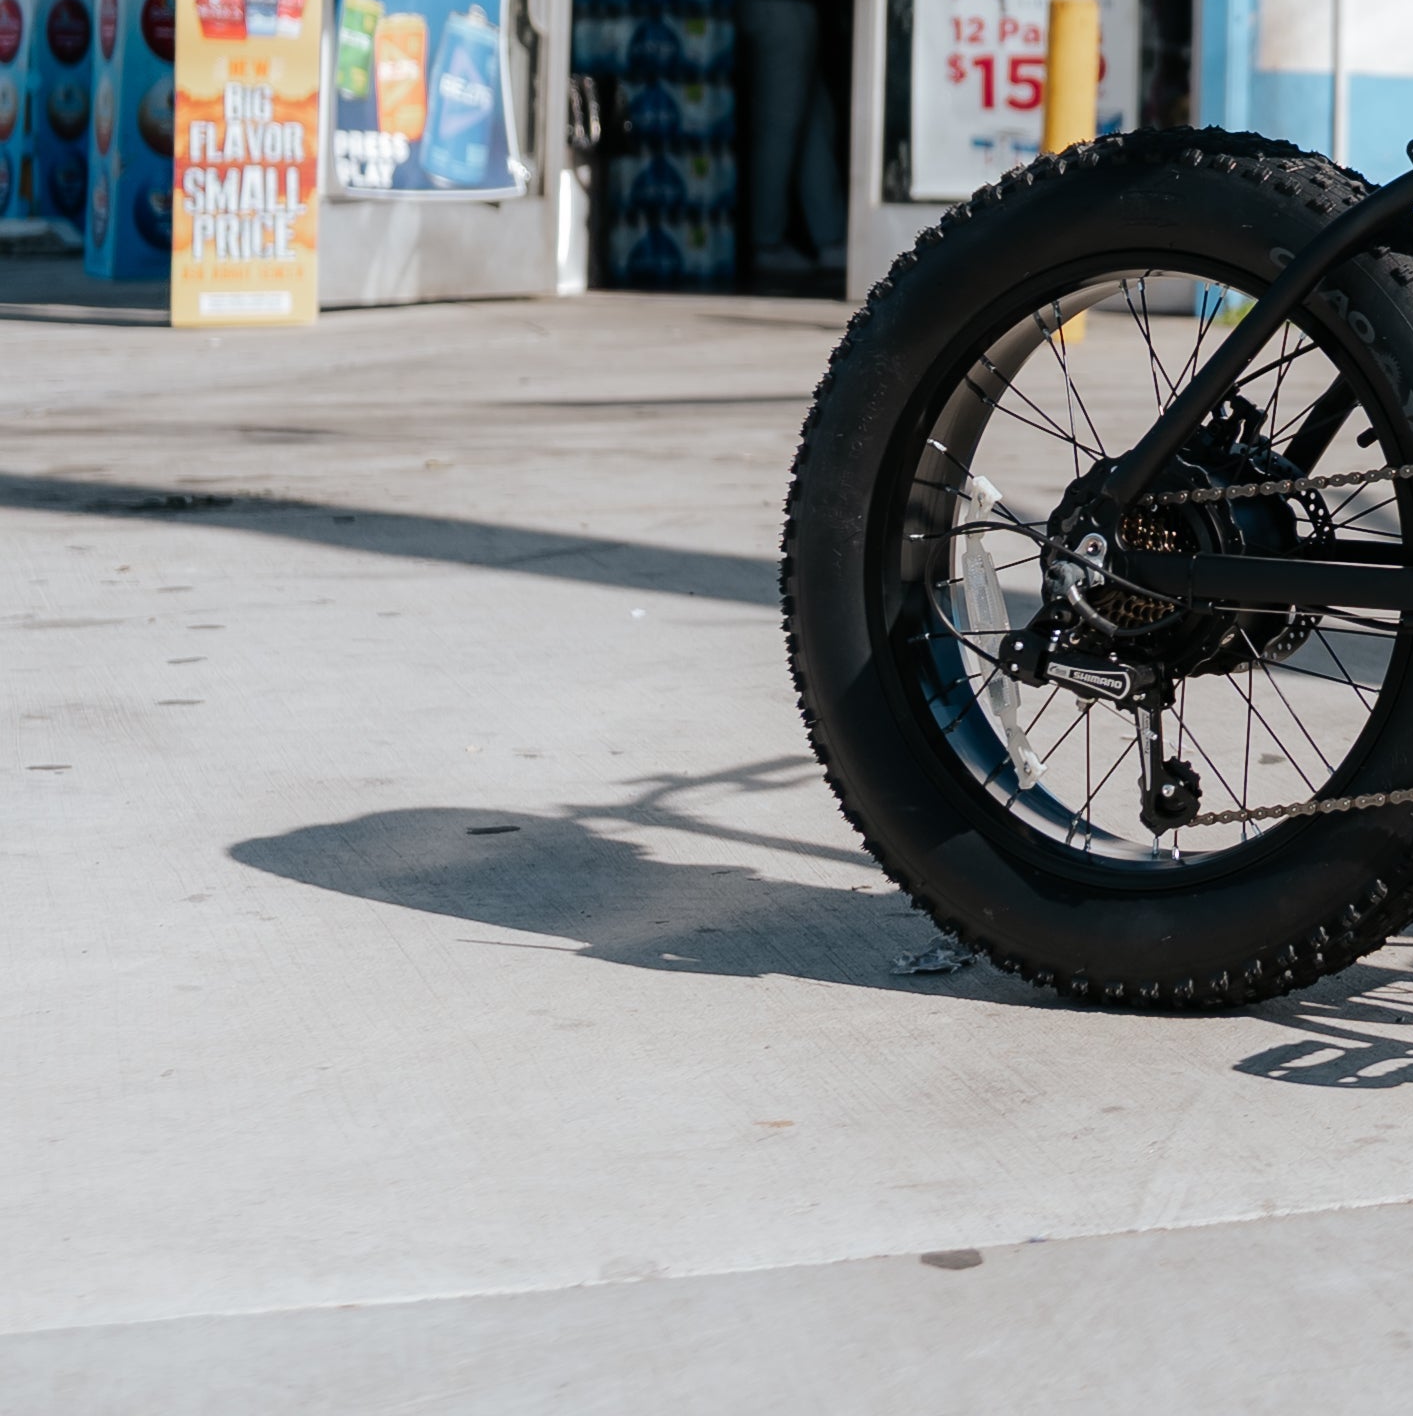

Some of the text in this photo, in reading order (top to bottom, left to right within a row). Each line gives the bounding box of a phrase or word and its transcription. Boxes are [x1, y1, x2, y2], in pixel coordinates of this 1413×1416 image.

[951, 16, 985, 45] 12
[223, 81, 274, 122] BIG
[188, 120, 305, 163] FLAVOR
[333, 130, 411, 164] PRESS
[182, 164, 308, 215] SMALL
[192, 210, 298, 263] PRICE
[1072, 671, 1123, 690] SHIMANO
